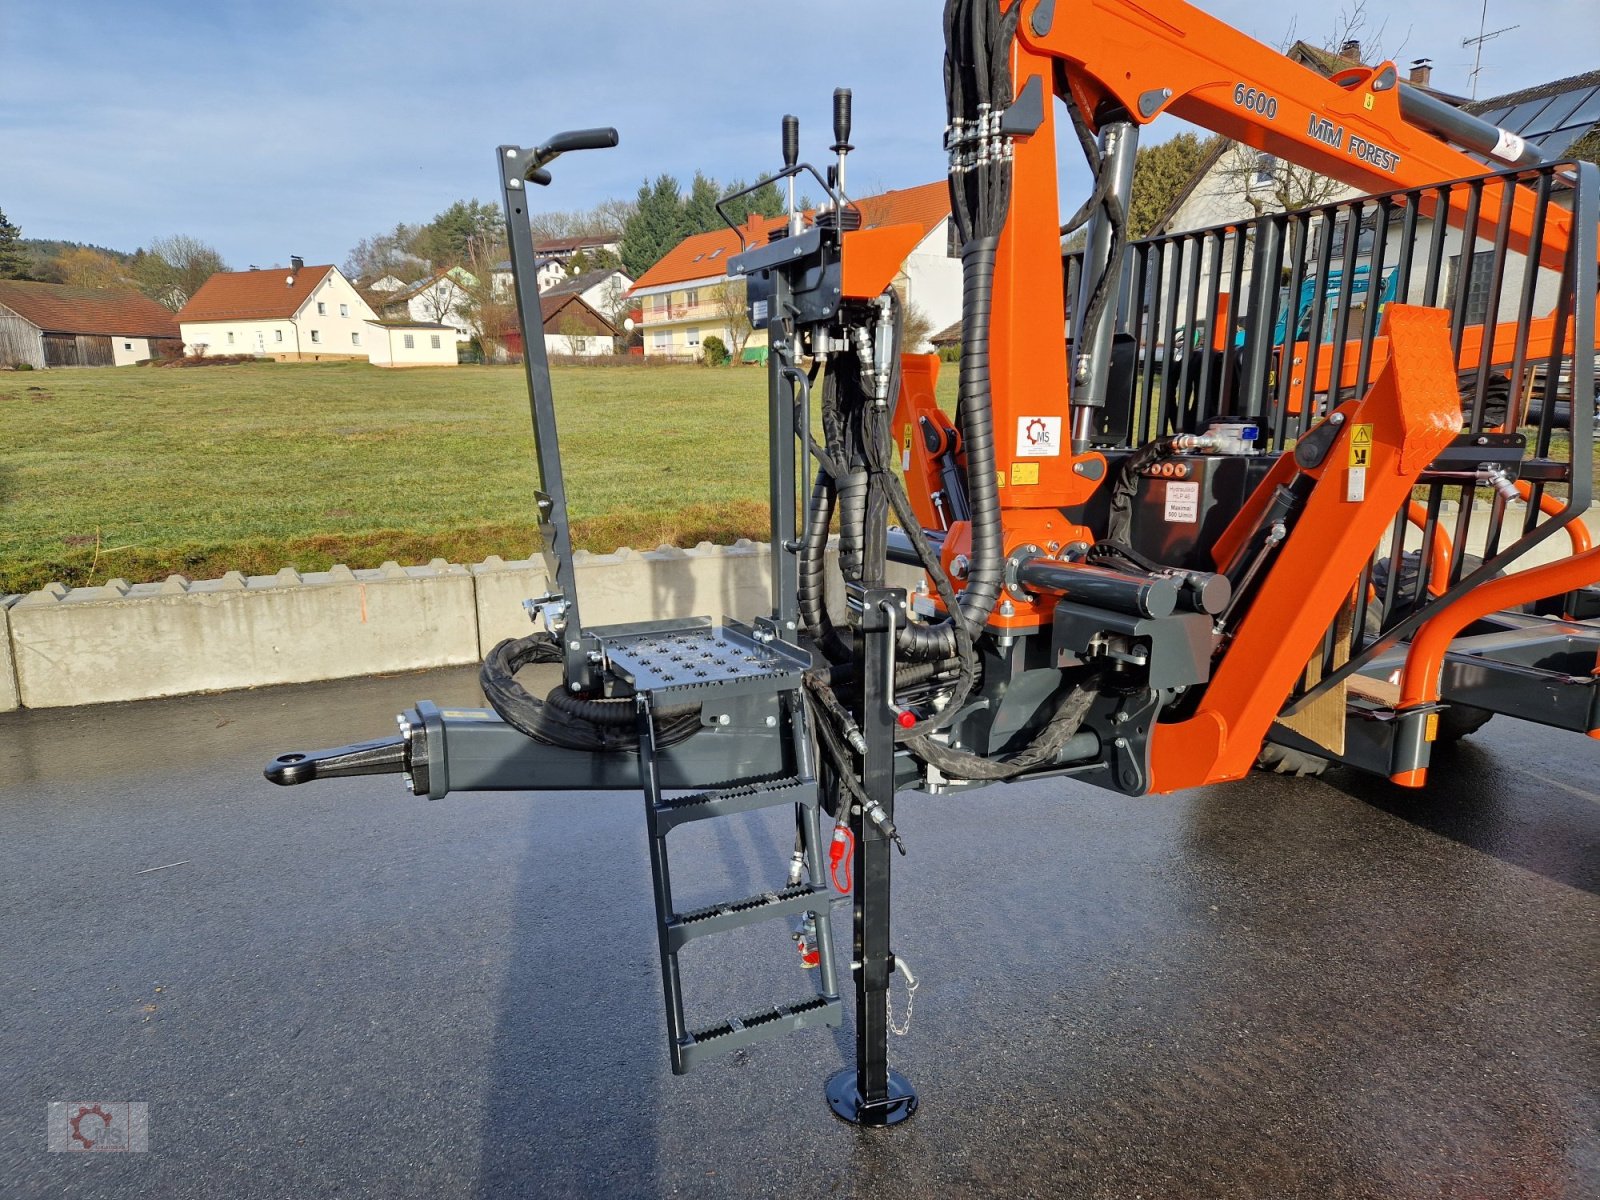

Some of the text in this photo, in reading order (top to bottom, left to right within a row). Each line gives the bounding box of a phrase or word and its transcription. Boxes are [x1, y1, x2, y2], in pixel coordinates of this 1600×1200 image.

[1234, 82, 1278, 120] 6600
[1307, 112, 1400, 174] MTM FOREST
